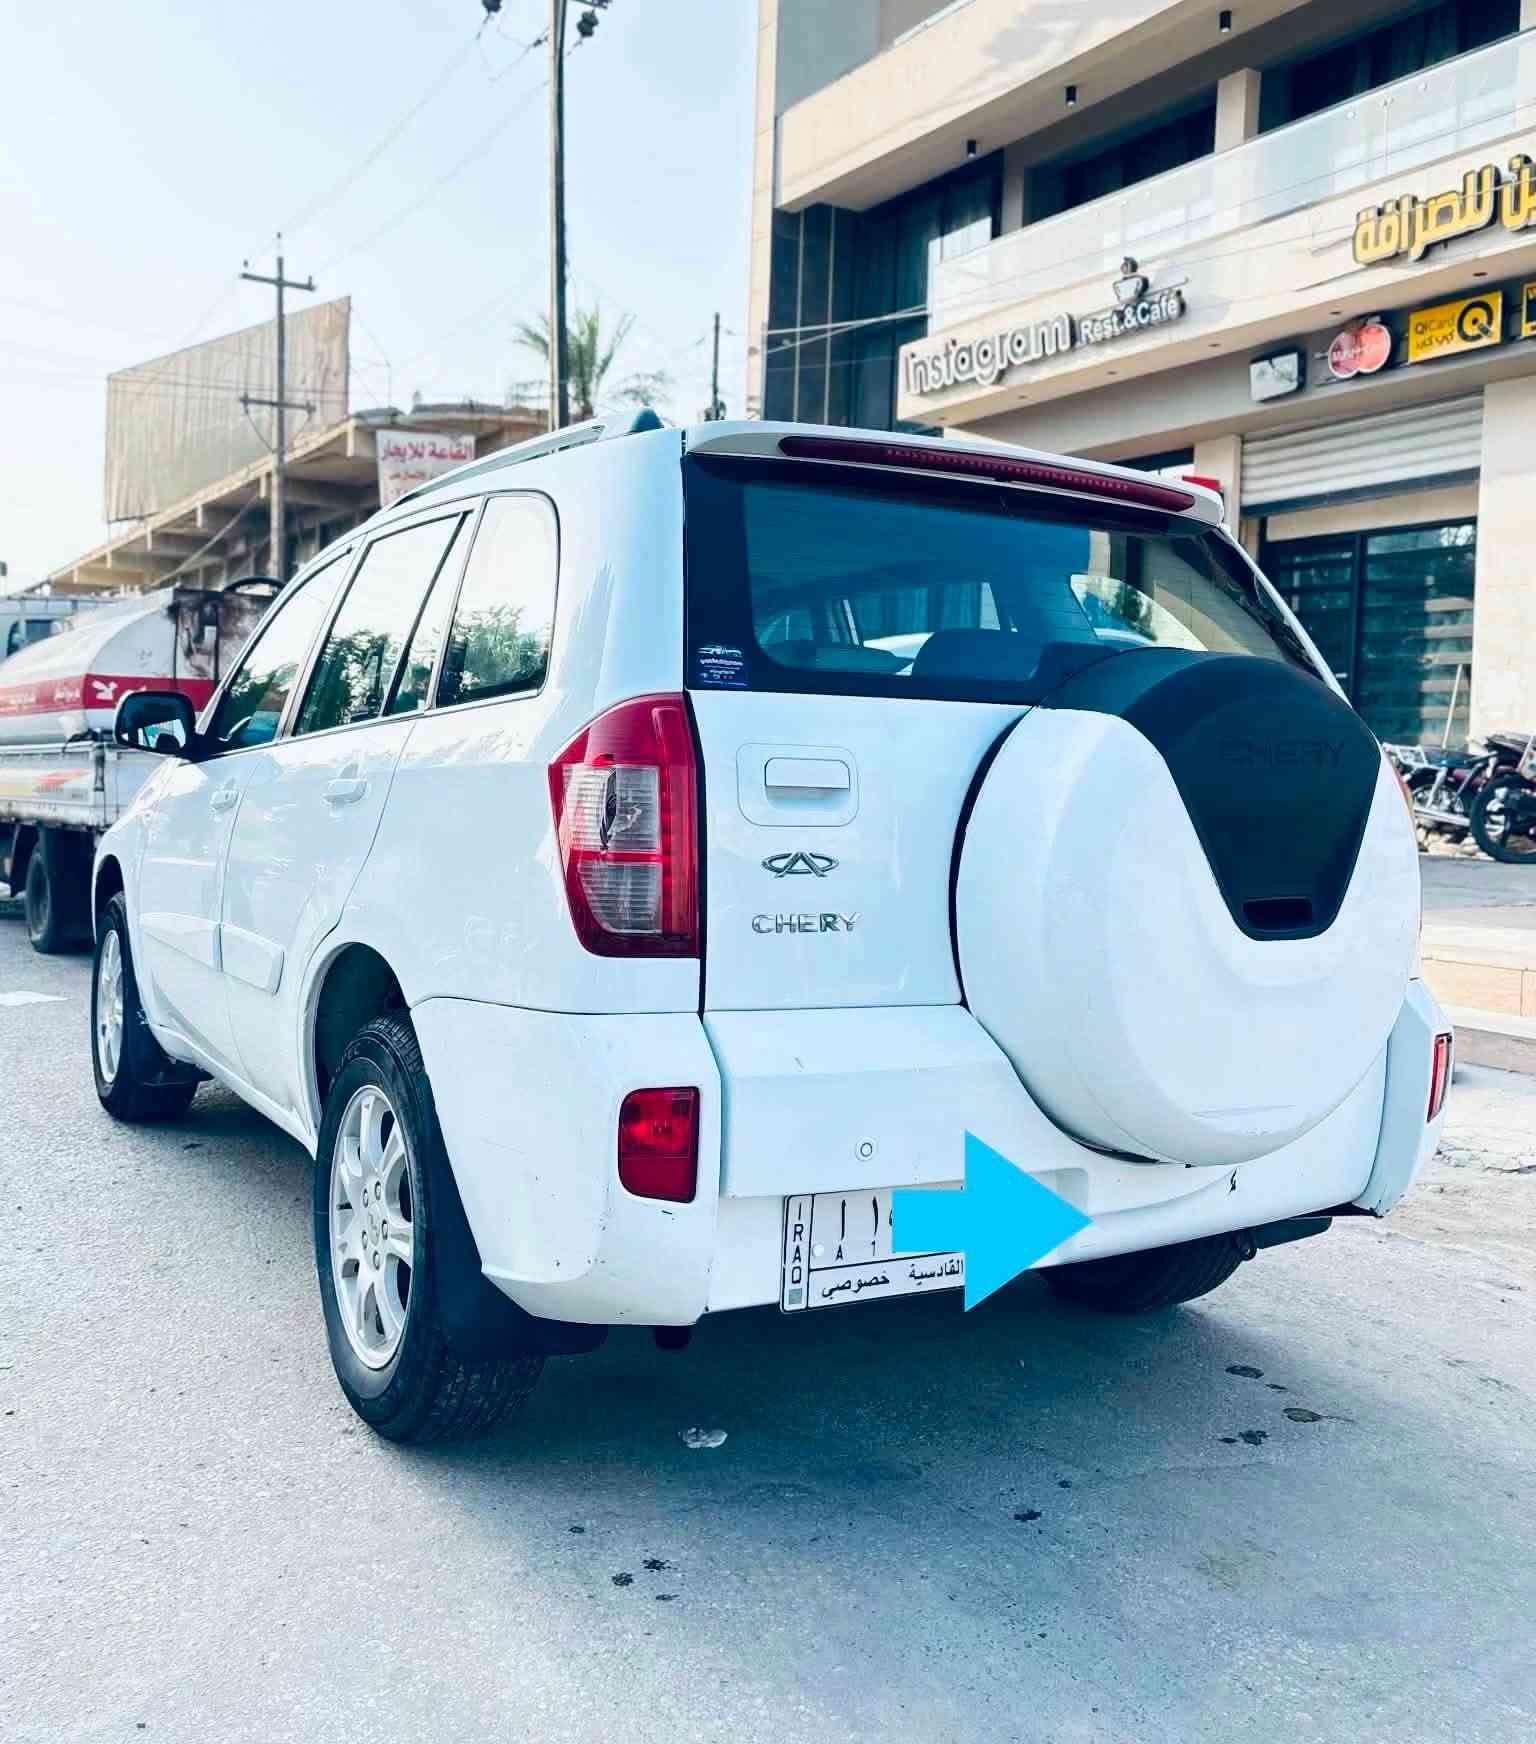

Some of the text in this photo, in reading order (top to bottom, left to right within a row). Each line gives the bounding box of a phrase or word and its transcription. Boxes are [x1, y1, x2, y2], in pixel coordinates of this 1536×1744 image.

[1353, 163, 1501, 265] للصرافة
[905, 312, 1076, 394] Instagram
[752, 912, 862, 934] CHERY
[791, 1201, 804, 1285] IRAQ
[822, 1258, 964, 1299] القادسية خصوصي
